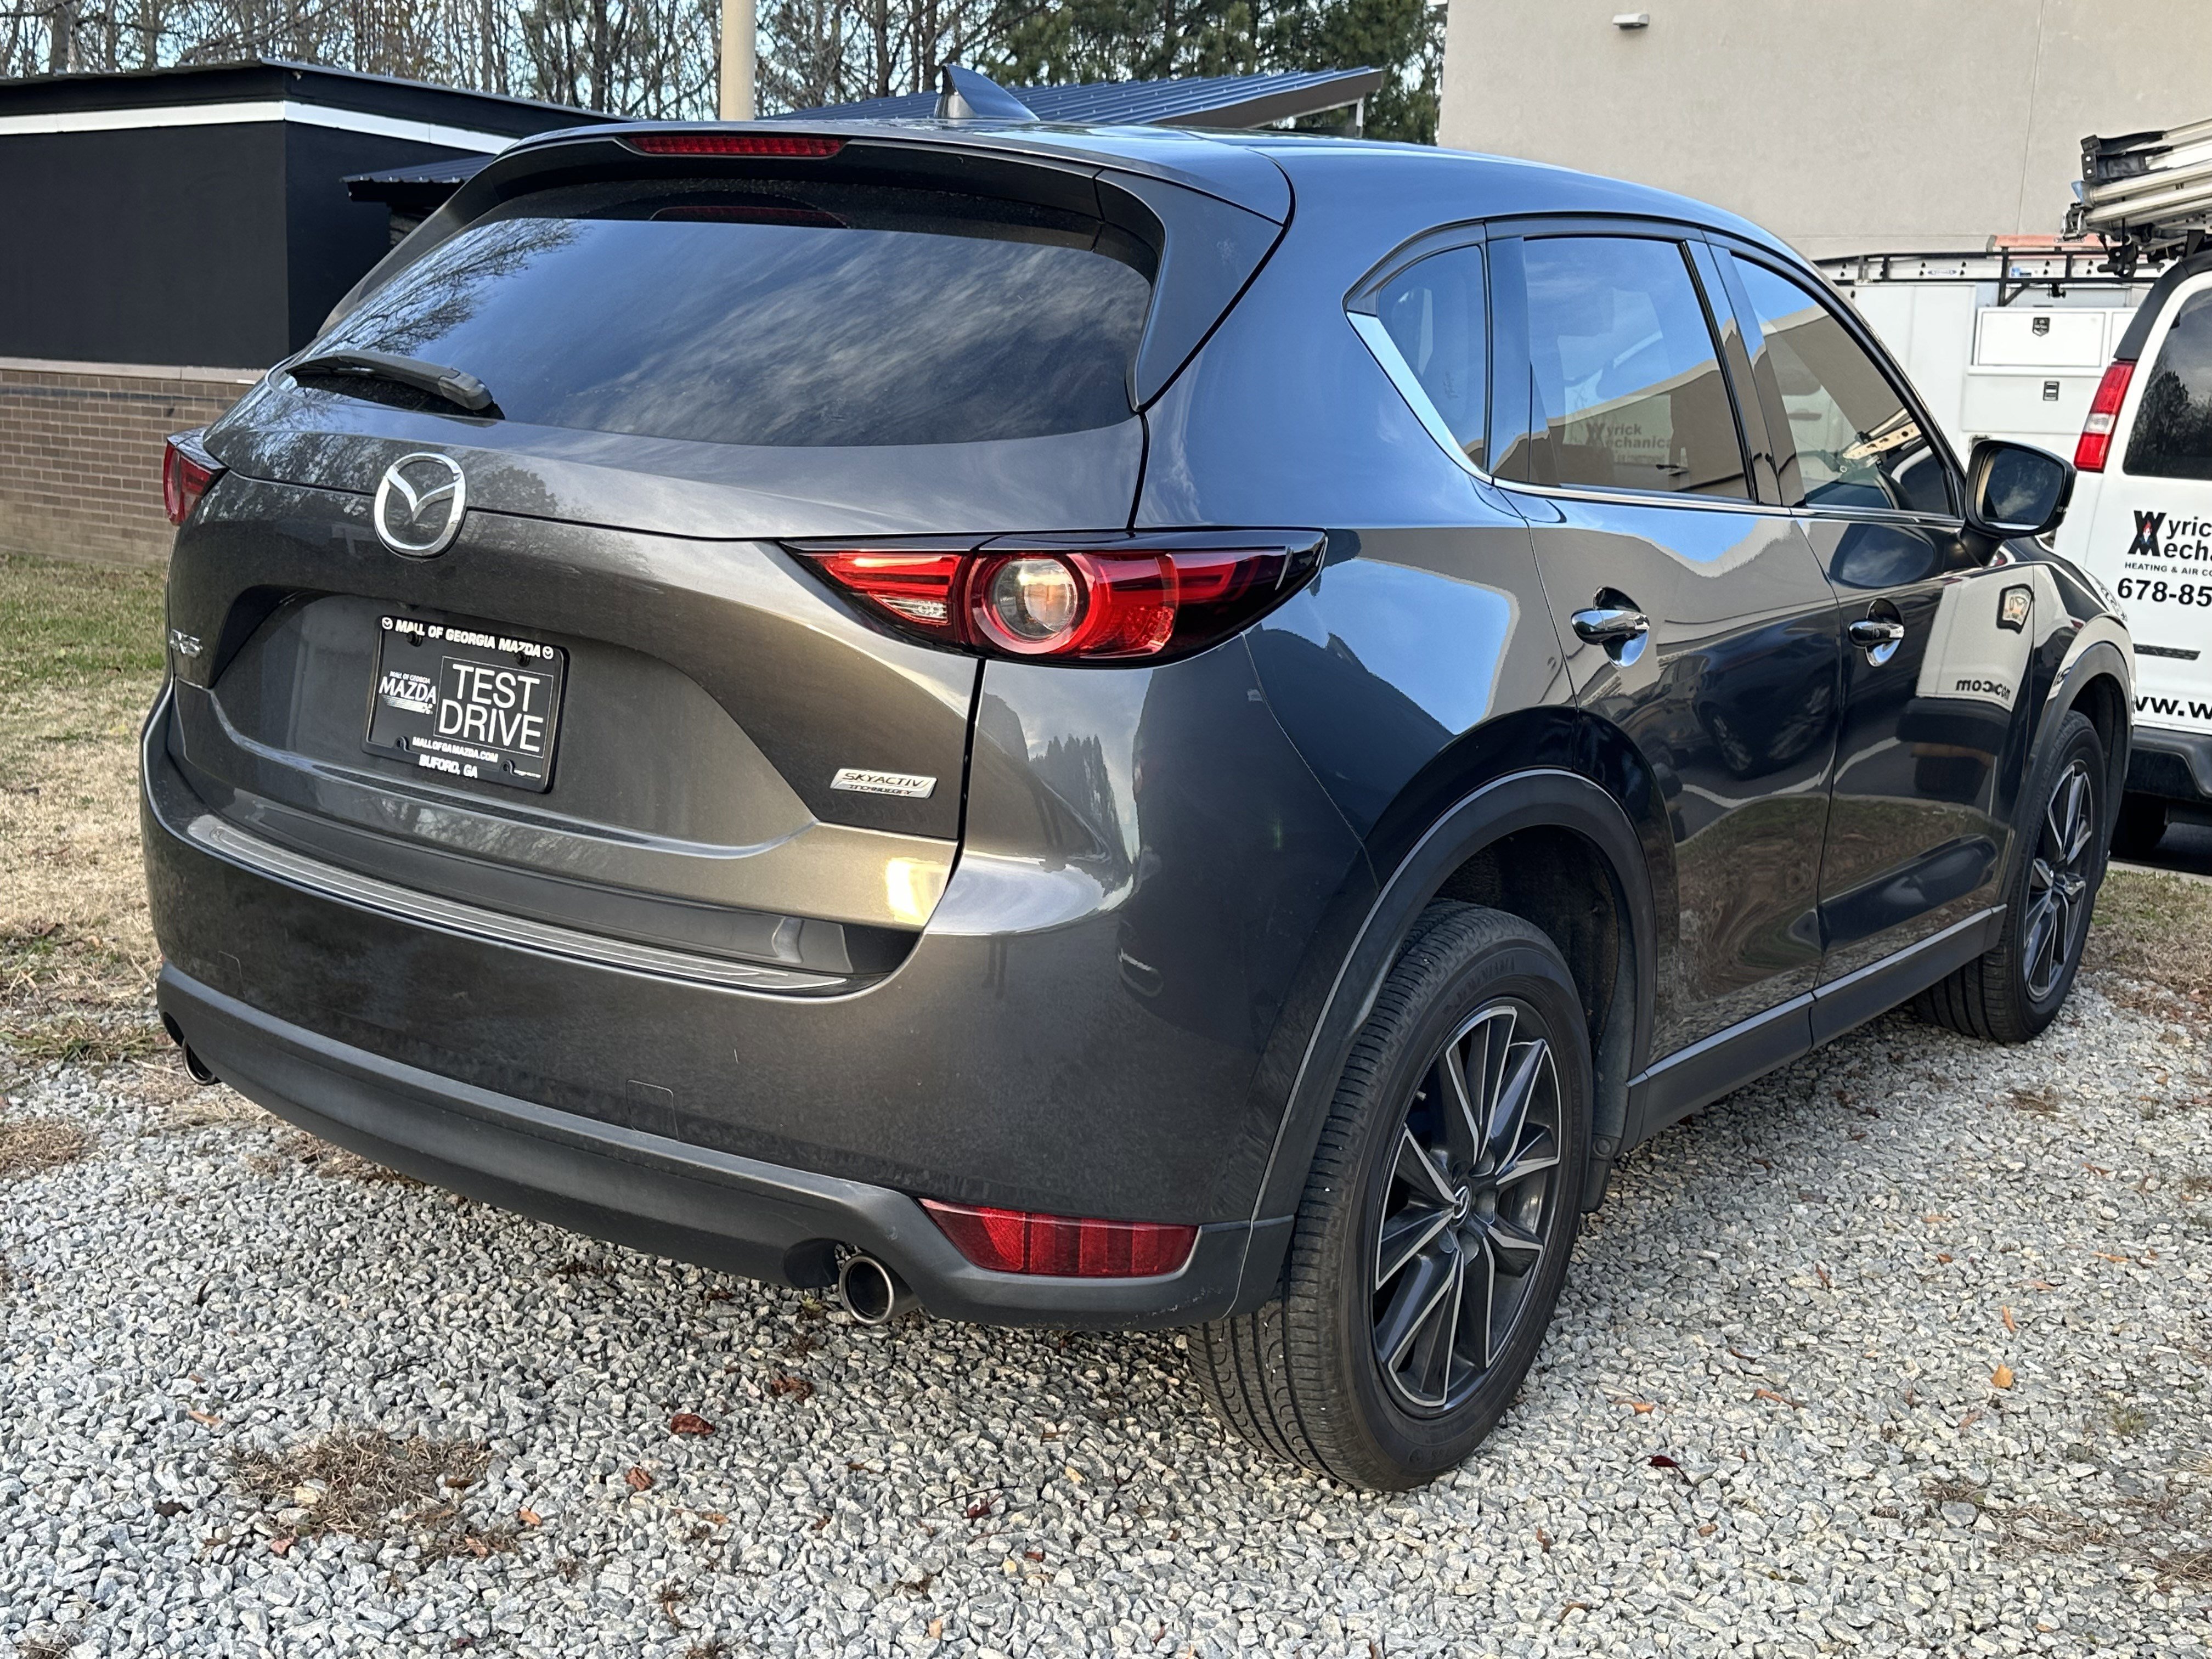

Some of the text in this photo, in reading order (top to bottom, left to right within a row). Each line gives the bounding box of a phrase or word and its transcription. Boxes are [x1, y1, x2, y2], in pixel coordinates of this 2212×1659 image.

[2124, 562, 2168, 573] HEATING
[2181, 567, 2199, 575] AIR
[2118, 578, 2212, 607] 678-85
[395, 619, 541, 658] MALL OF GEORGIA MAZDA
[379, 676, 437, 704] MAZDA
[453, 664, 540, 712] TEST
[439, 699, 543, 752] DRIVE
[419, 754, 478, 778] BUFORD, GA
[843, 772, 924, 787] SKYACTIV
